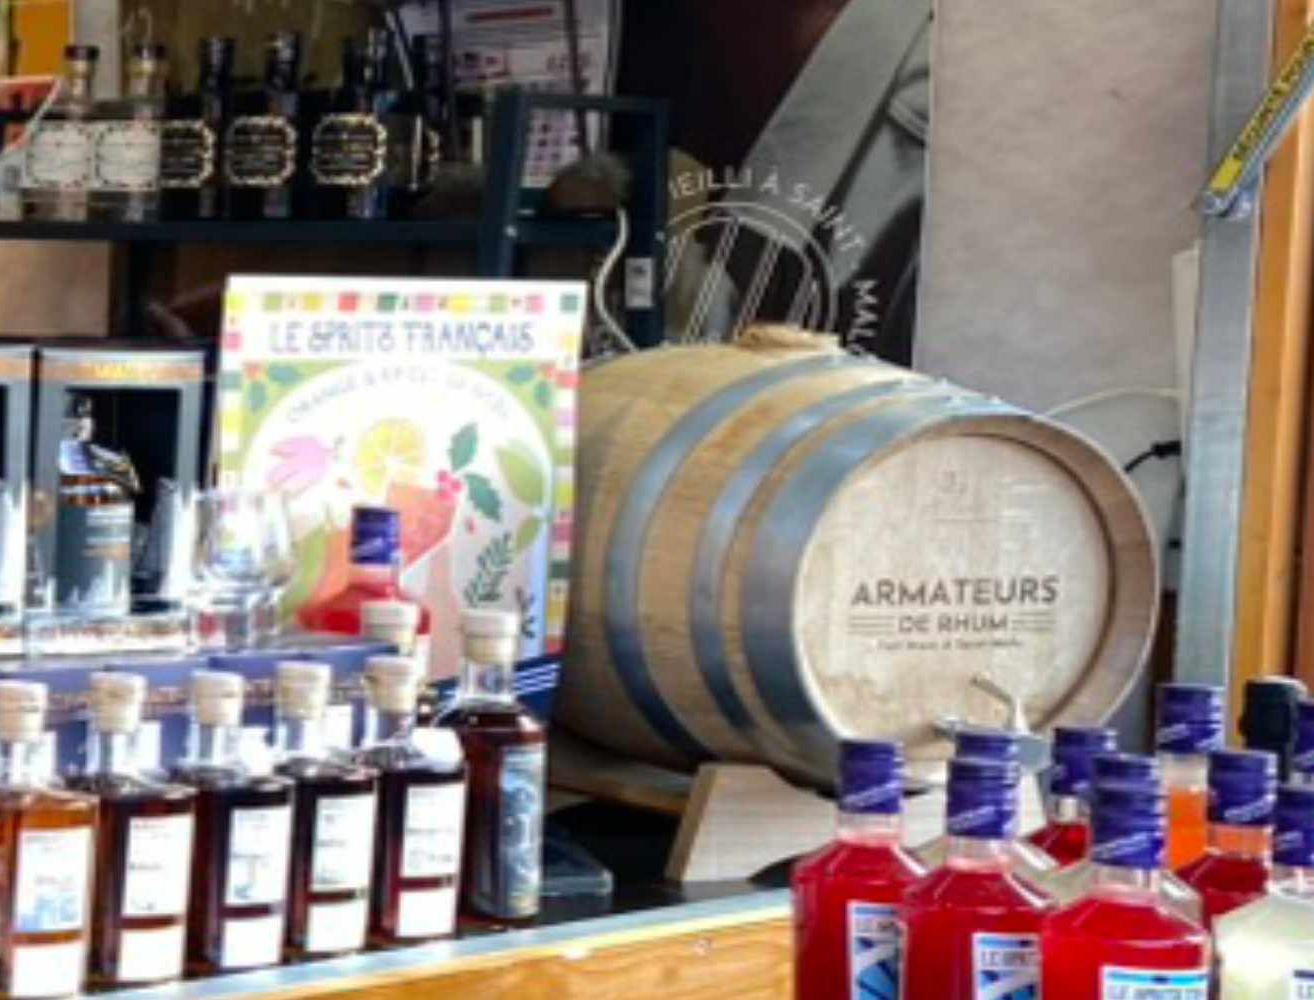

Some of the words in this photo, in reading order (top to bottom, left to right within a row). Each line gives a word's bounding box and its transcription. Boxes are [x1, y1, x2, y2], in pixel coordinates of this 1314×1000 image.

[669, 165, 753, 199] IEILLI
[269, 321, 302, 354] LE
[851, 574, 1060, 606] ARMATEURS
[898, 614, 930, 633] DE
[936, 613, 1009, 633] RHUM
